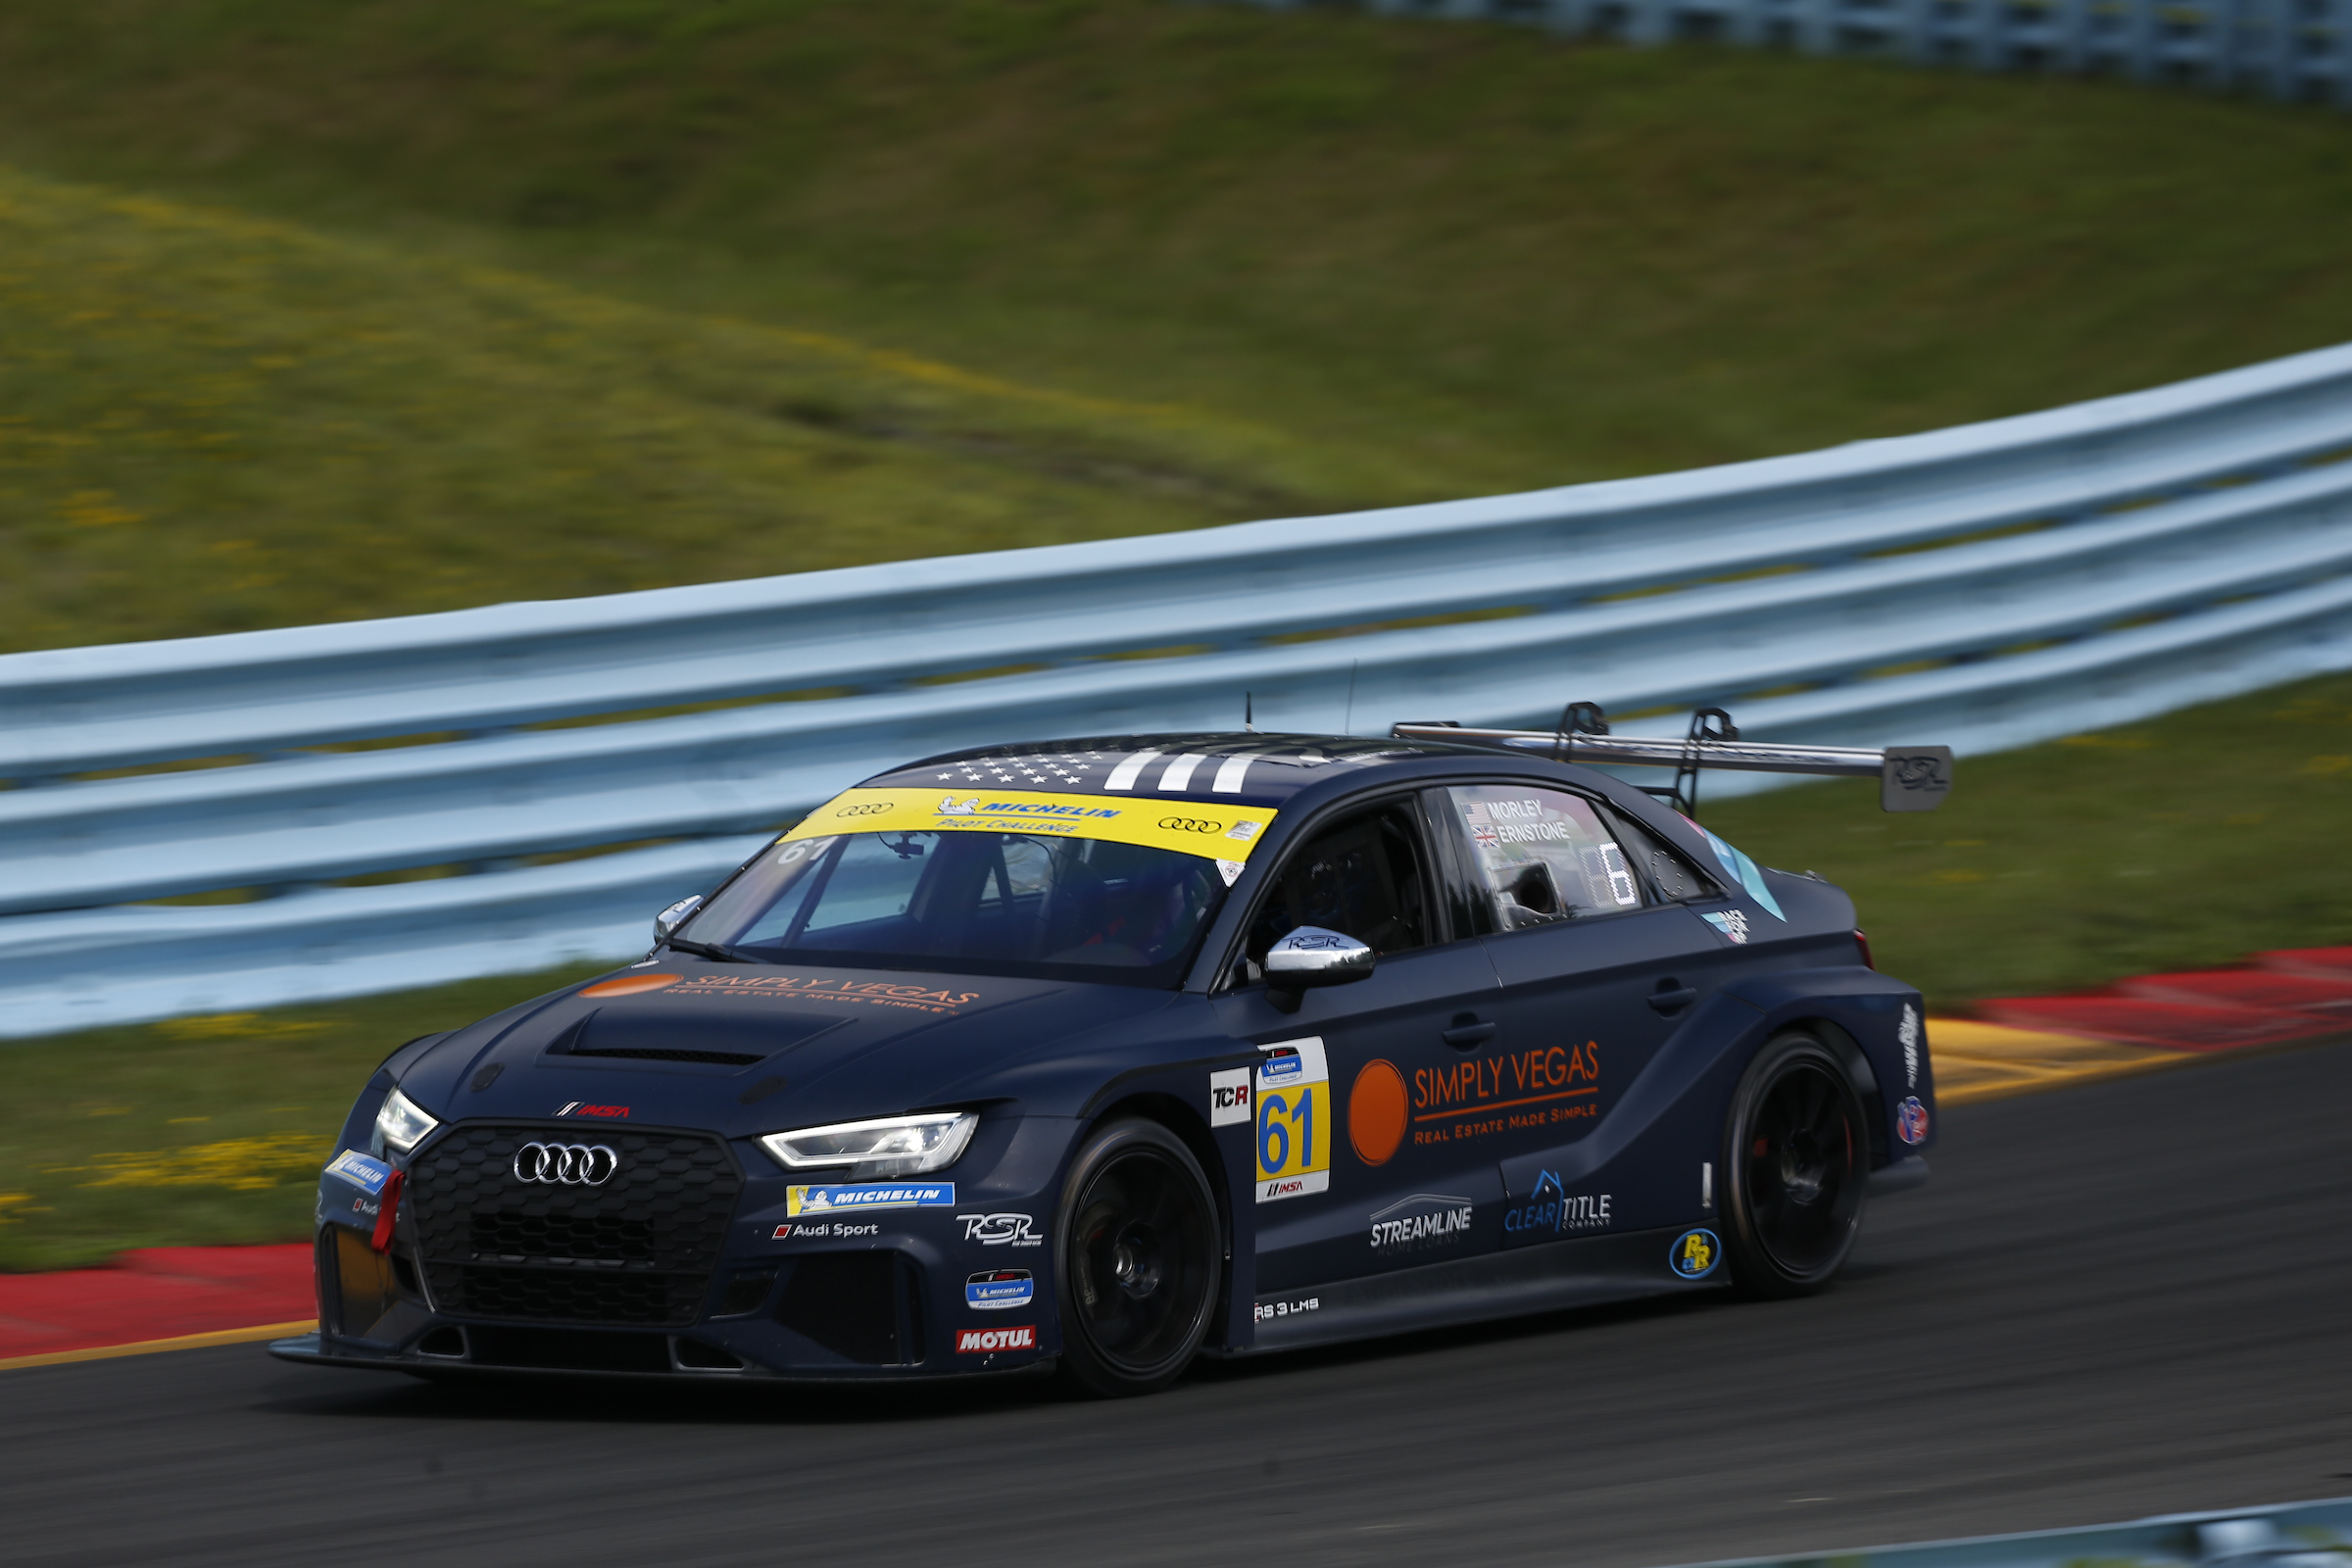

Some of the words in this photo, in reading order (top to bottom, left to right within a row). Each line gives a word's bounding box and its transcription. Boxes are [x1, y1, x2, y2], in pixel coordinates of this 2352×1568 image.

[980, 803, 1122, 818] MICHELIN
[1487, 799, 1544, 820] MORLEY
[1495, 821, 1570, 844] ERNSTONE
[778, 835, 839, 864] 61
[686, 975, 834, 991] SIMPLY
[841, 980, 980, 1004] VEGAS
[1414, 1055, 1504, 1108] SIMPLY
[1510, 1040, 1599, 1092] VEGAS
[1213, 1085, 1249, 1108] TCR
[575, 1104, 630, 1118] IMSA
[1258, 1088, 1313, 1174] 61
[1414, 1129, 1450, 1146] REAL
[1454, 1119, 1504, 1139] ESTATE
[1509, 1112, 1546, 1129] MADE
[1550, 1103, 1597, 1123] SIMPLE
[834, 1189, 941, 1204] MICHELIN
[1278, 1180, 1303, 1195] IMSA
[1504, 1202, 1556, 1232] CLEAR
[1562, 1195, 1612, 1220] TITLE
[793, 1223, 830, 1237] Audi
[833, 1223, 879, 1239] Sport
[956, 1212, 1044, 1246] RSR
[1370, 1206, 1472, 1248] STREAMLINE
[1277, 1301, 1288, 1316] 3
[1290, 1298, 1319, 1313] LMS
[959, 1329, 1033, 1350] MOTUL
